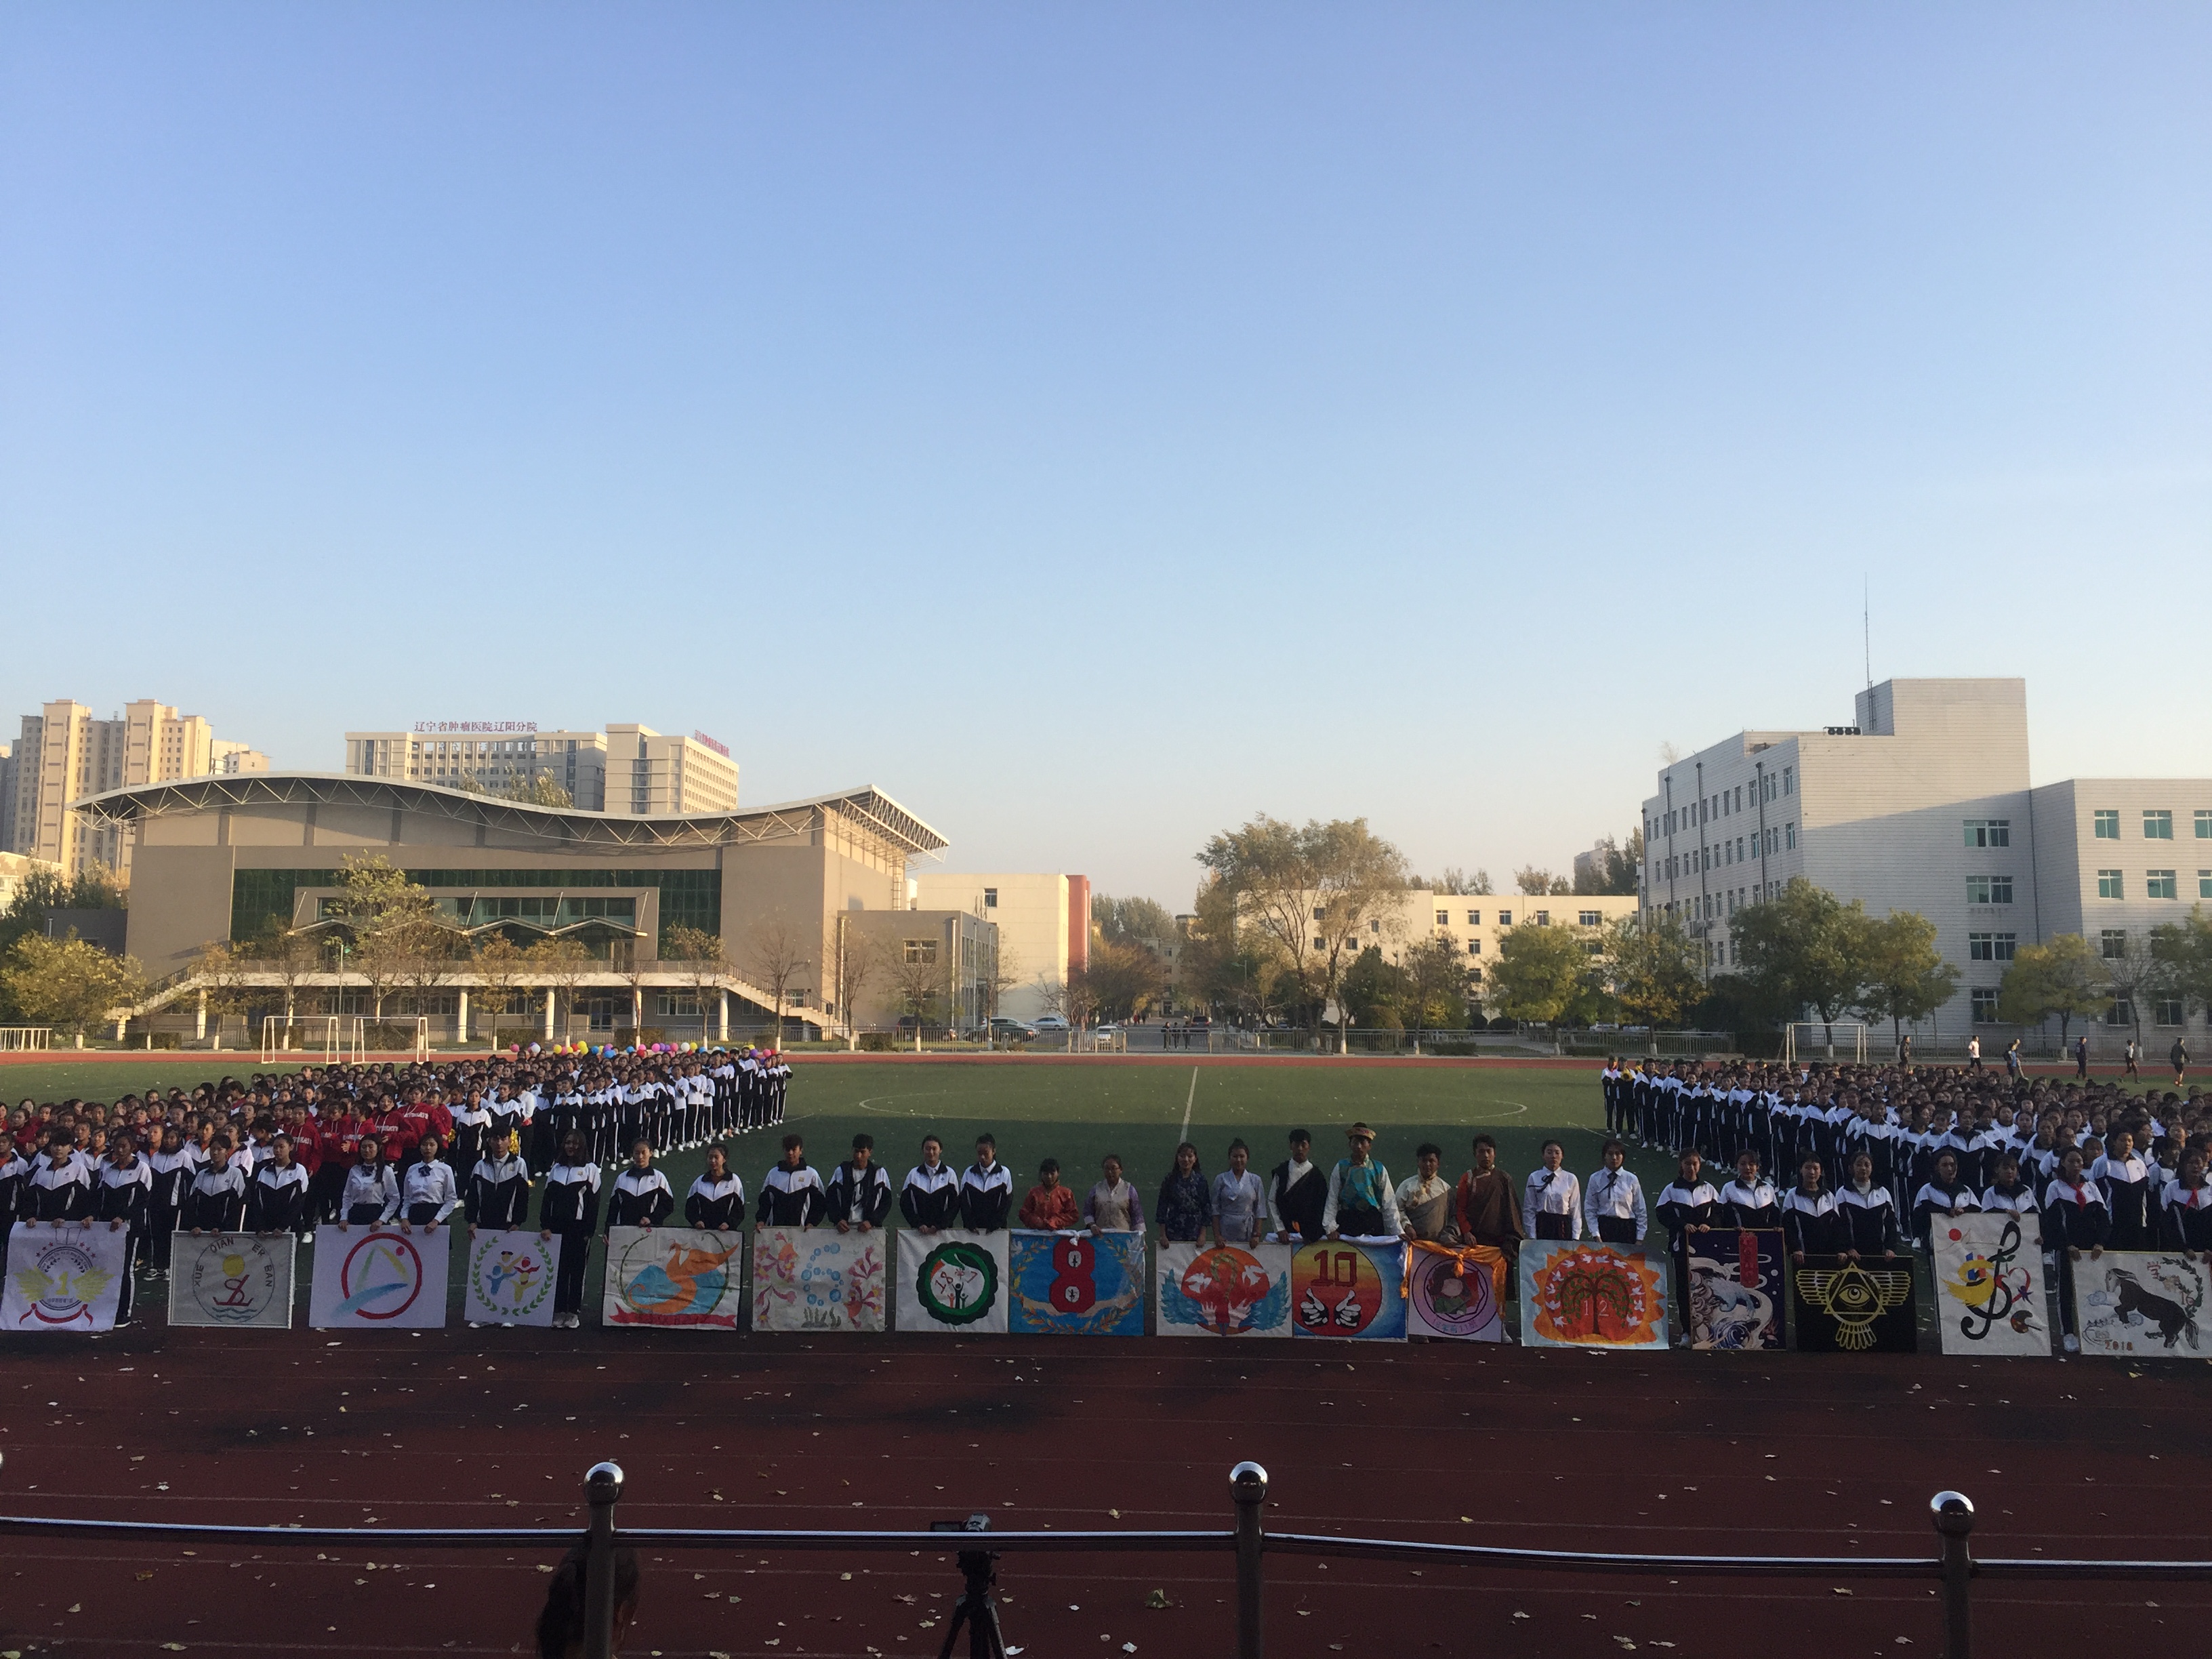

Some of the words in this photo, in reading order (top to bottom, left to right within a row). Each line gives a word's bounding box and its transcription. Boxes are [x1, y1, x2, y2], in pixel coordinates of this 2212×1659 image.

[414, 721, 537, 732] 辽宁省肿瘤医院辽阳分院
[194, 1264, 204, 1287] XUE
[209, 1236, 235, 1253] QIAN
[251, 1243, 266, 1257] ER
[264, 1264, 272, 1288] BAN
[1049, 1236, 1096, 1313] 8
[1311, 1250, 1357, 1287] 10
[56, 1271, 69, 1296] 1
[1583, 1300, 1610, 1317] 12
